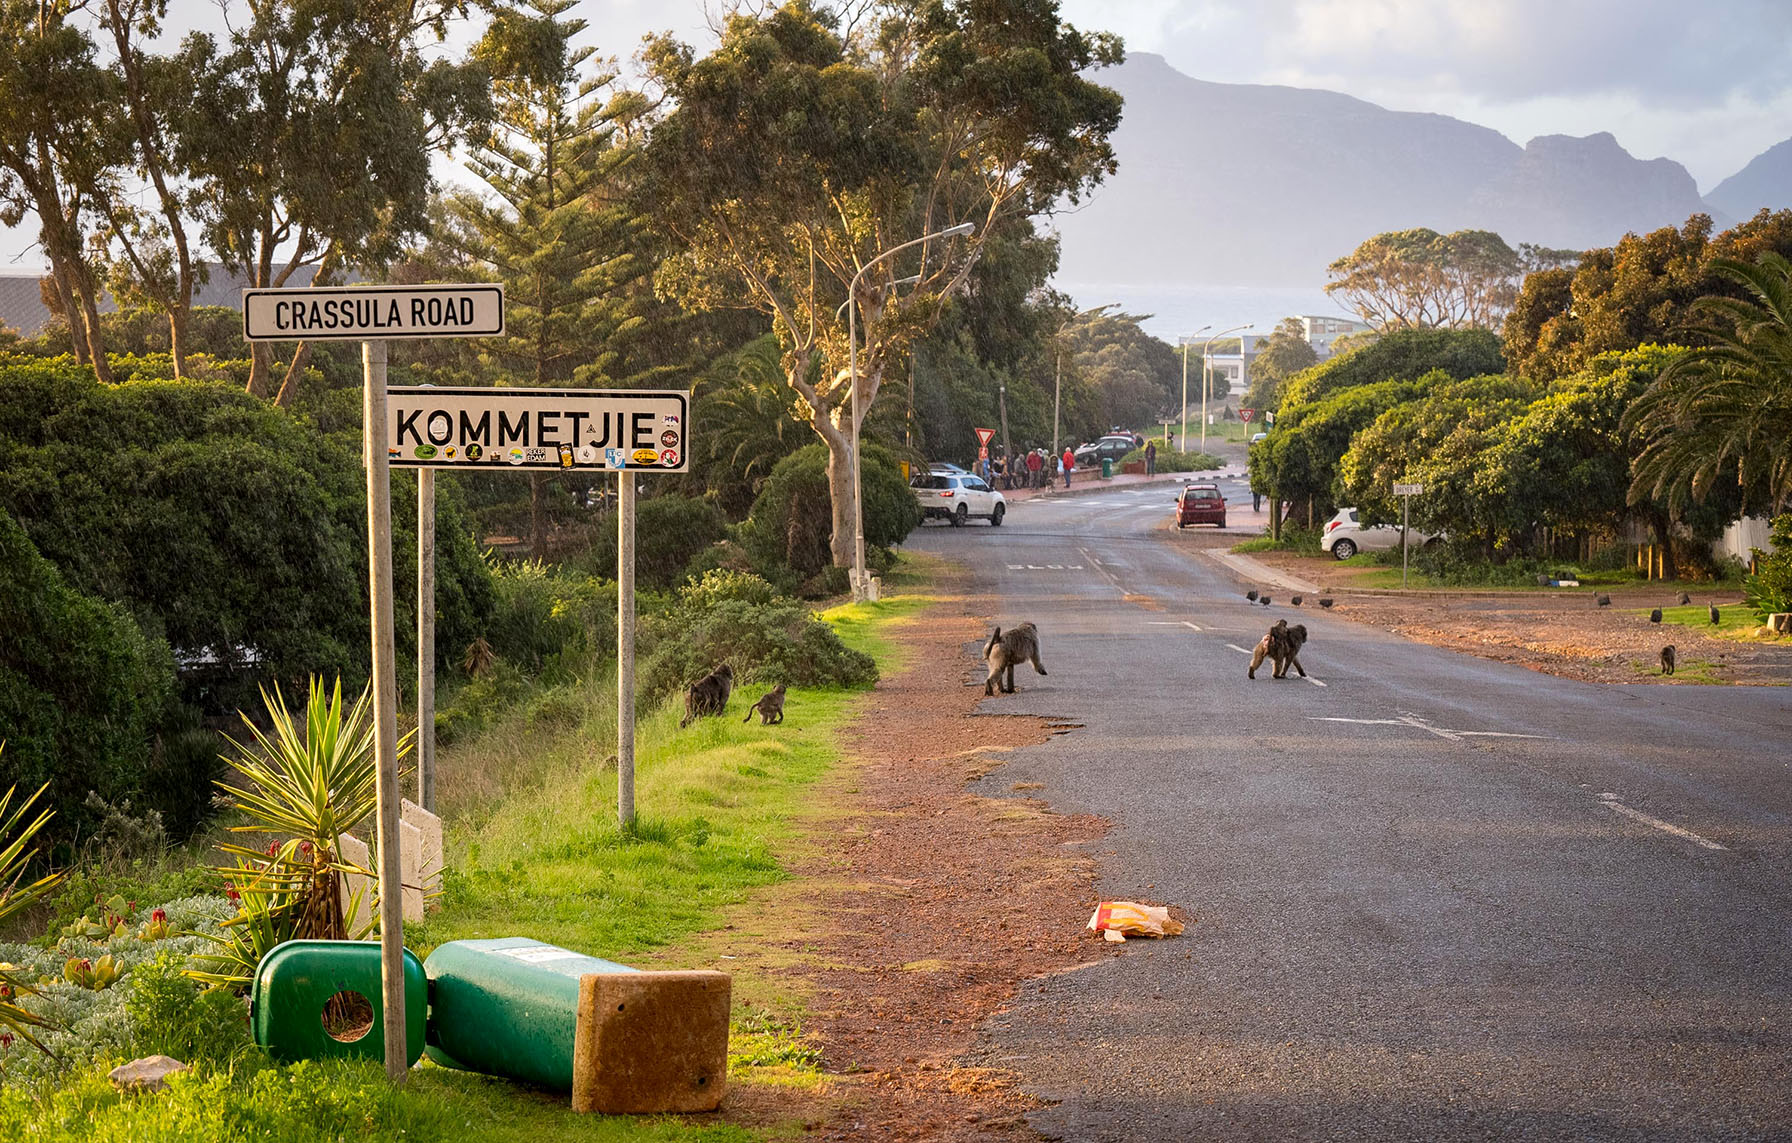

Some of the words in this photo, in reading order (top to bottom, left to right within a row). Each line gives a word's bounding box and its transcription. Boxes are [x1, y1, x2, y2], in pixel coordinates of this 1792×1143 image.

[276, 298, 402, 330] CRASSULA
[411, 296, 474, 328] ROAD
[396, 409, 656, 450] KOMMETJIE
